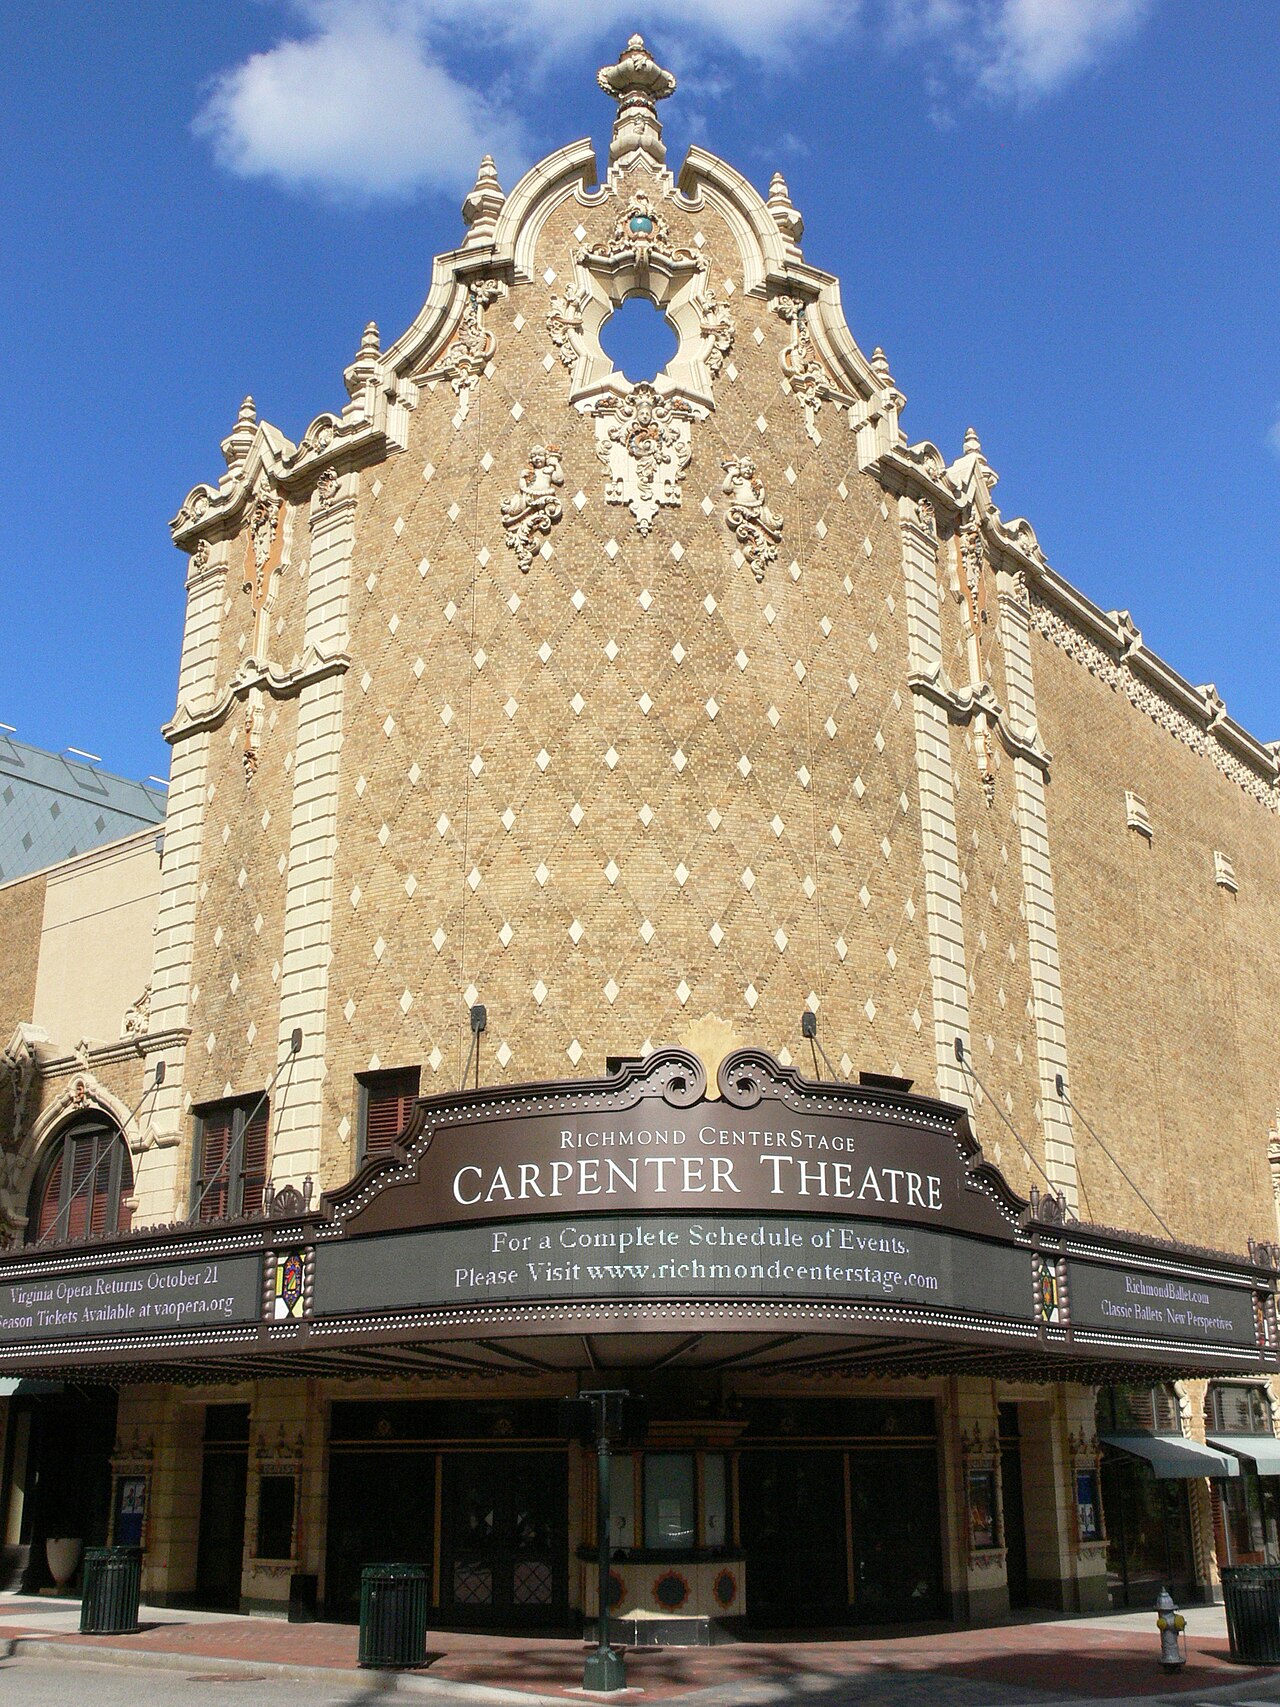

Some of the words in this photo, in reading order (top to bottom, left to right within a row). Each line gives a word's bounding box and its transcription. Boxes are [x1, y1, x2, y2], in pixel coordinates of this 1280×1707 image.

[453, 1157, 742, 1205] CARPENTER
[759, 1154, 943, 1210] THEATRE
[491, 1231, 531, 1253] For
[539, 1235, 552, 1249] a
[559, 1226, 679, 1253] Complete
[689, 1224, 803, 1246] Schedule
[811, 1228, 835, 1248] of
[838, 1228, 910, 1255] Events.
[10, 1285, 53, 1307] Virginia
[56, 1282, 92, 1304] Opera
[94, 1278, 143, 1295] Returns
[147, 1269, 201, 1290] October
[204, 1266, 218, 1284] 21
[454, 1267, 519, 1288] Please
[525, 1261, 580, 1282] Visit
[586, 1258, 938, 1293] www.richmondcenterstage.com
[37, 1310, 78, 1326] Tickets
[81, 1303, 135, 1321] Available
[139, 1303, 152, 1318] at
[154, 1297, 235, 1322] vaopera.org
[1101, 1299, 1132, 1318] Classic
[1134, 1303, 1162, 1322] Ballets
[1166, 1308, 1185, 1324] New
[1187, 1311, 1233, 1333] Perspectives
